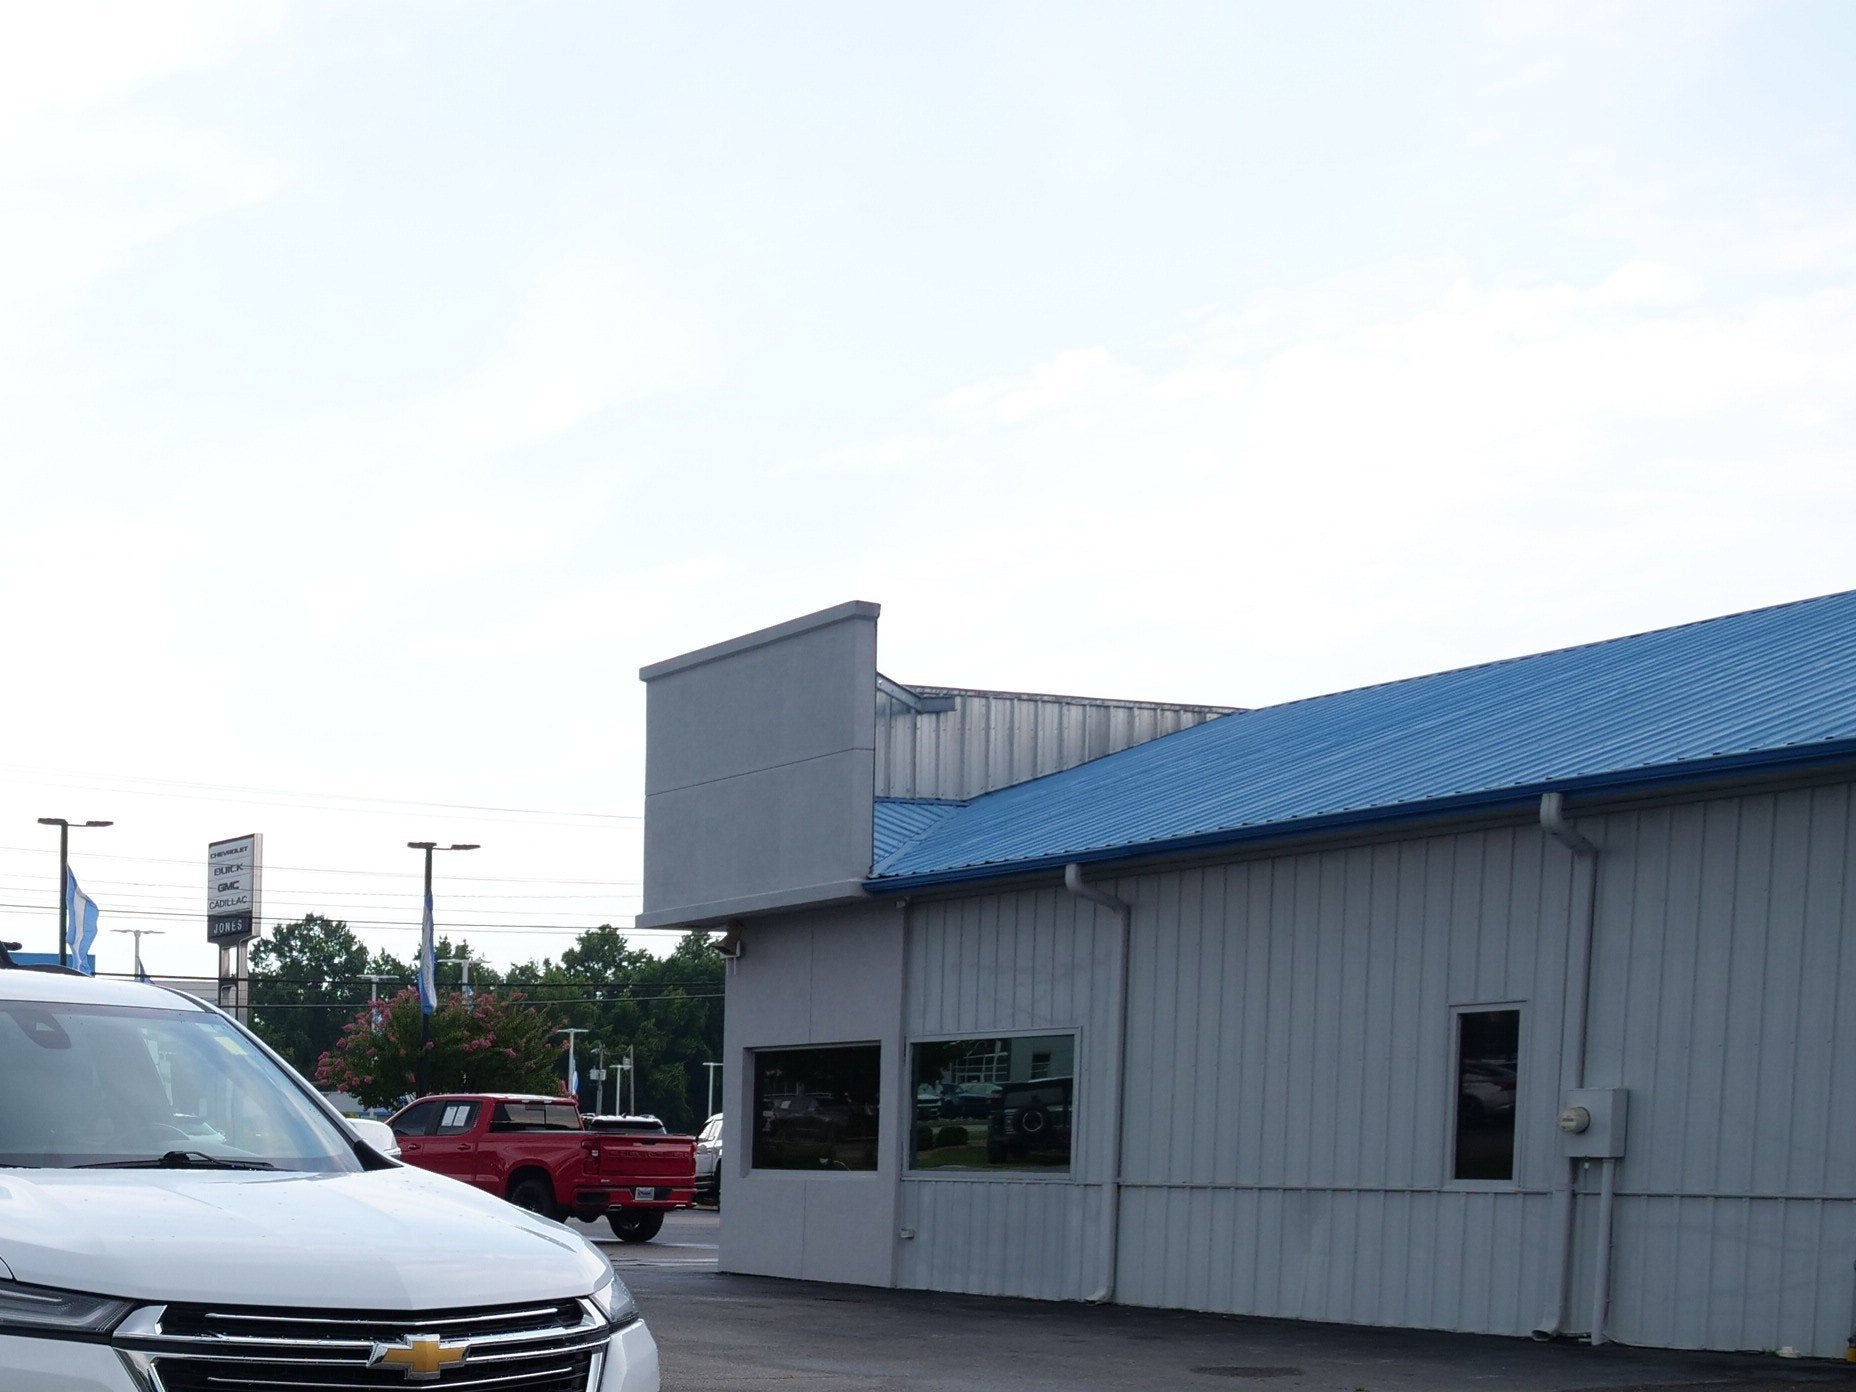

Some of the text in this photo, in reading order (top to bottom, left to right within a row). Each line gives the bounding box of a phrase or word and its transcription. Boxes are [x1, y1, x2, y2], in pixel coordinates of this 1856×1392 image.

[210, 846, 248, 859] CHEVROLET
[214, 863, 244, 876] BUICK
[217, 880, 240, 892] GMC
[209, 896, 248, 909] CADILLAC
[213, 920, 242, 934] JONES
